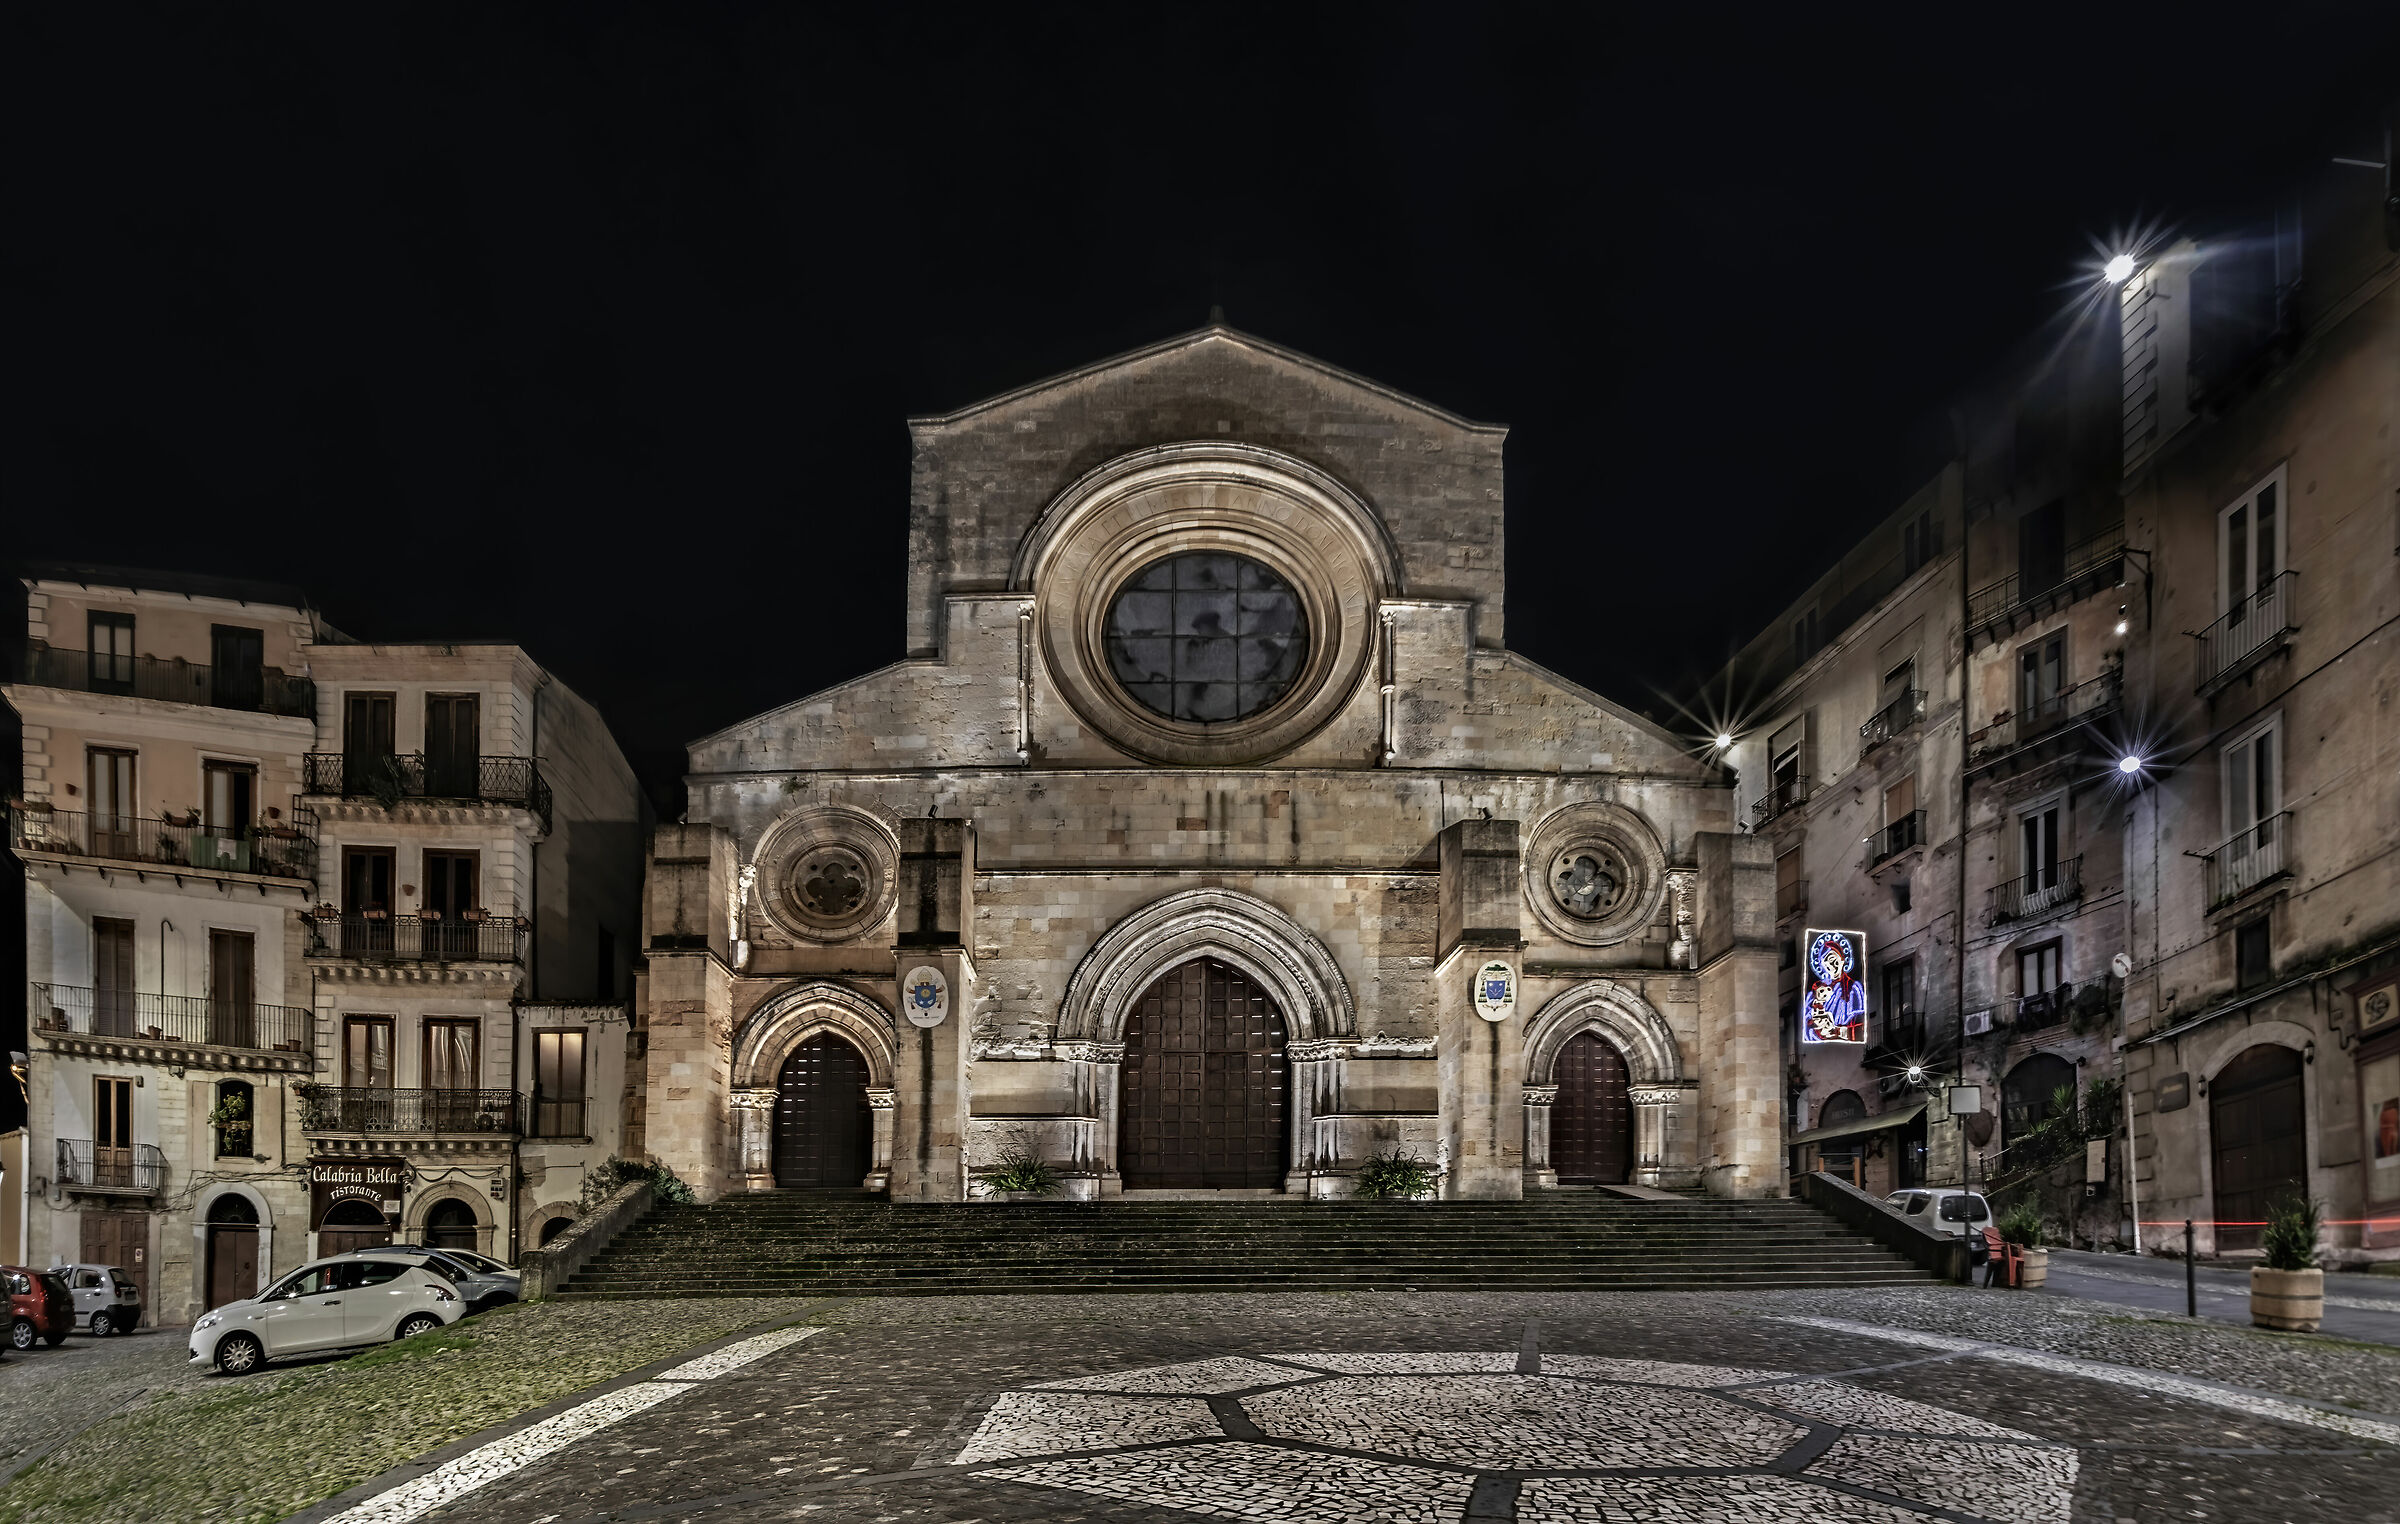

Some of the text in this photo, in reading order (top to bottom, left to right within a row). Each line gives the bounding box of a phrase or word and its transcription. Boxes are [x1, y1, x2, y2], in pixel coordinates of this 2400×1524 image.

[1233, 493, 1293, 521] ANNO
[313, 1165, 397, 1184] Calabria Bella
[330, 1185, 382, 1202] ristorante
